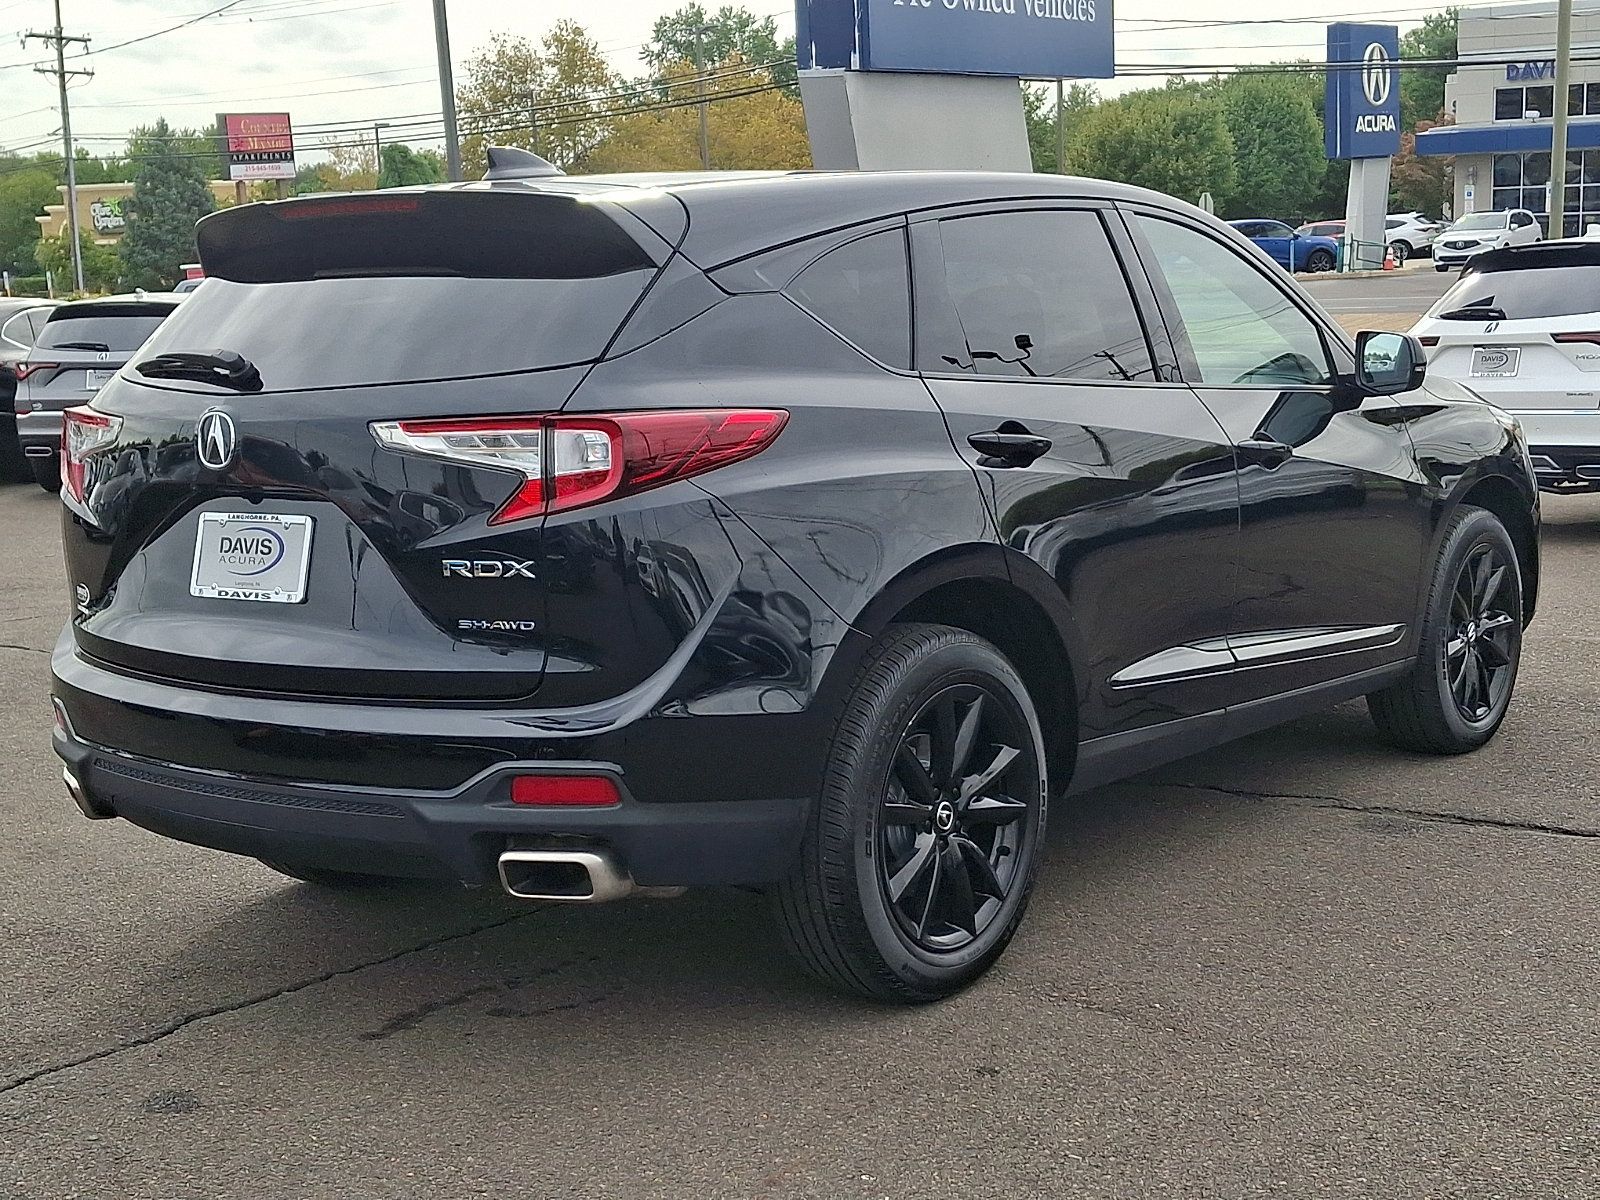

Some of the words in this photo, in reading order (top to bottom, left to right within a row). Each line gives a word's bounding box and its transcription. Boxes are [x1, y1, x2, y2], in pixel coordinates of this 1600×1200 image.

[1506, 60, 1557, 80] DAVI
[1355, 114, 1396, 132] ACURA
[219, 537, 273, 556] DAVIS
[218, 555, 266, 565] ACURA
[441, 559, 536, 579] RDX
[217, 590, 272, 600] DAVIS
[458, 619, 535, 630] SH-AWD
